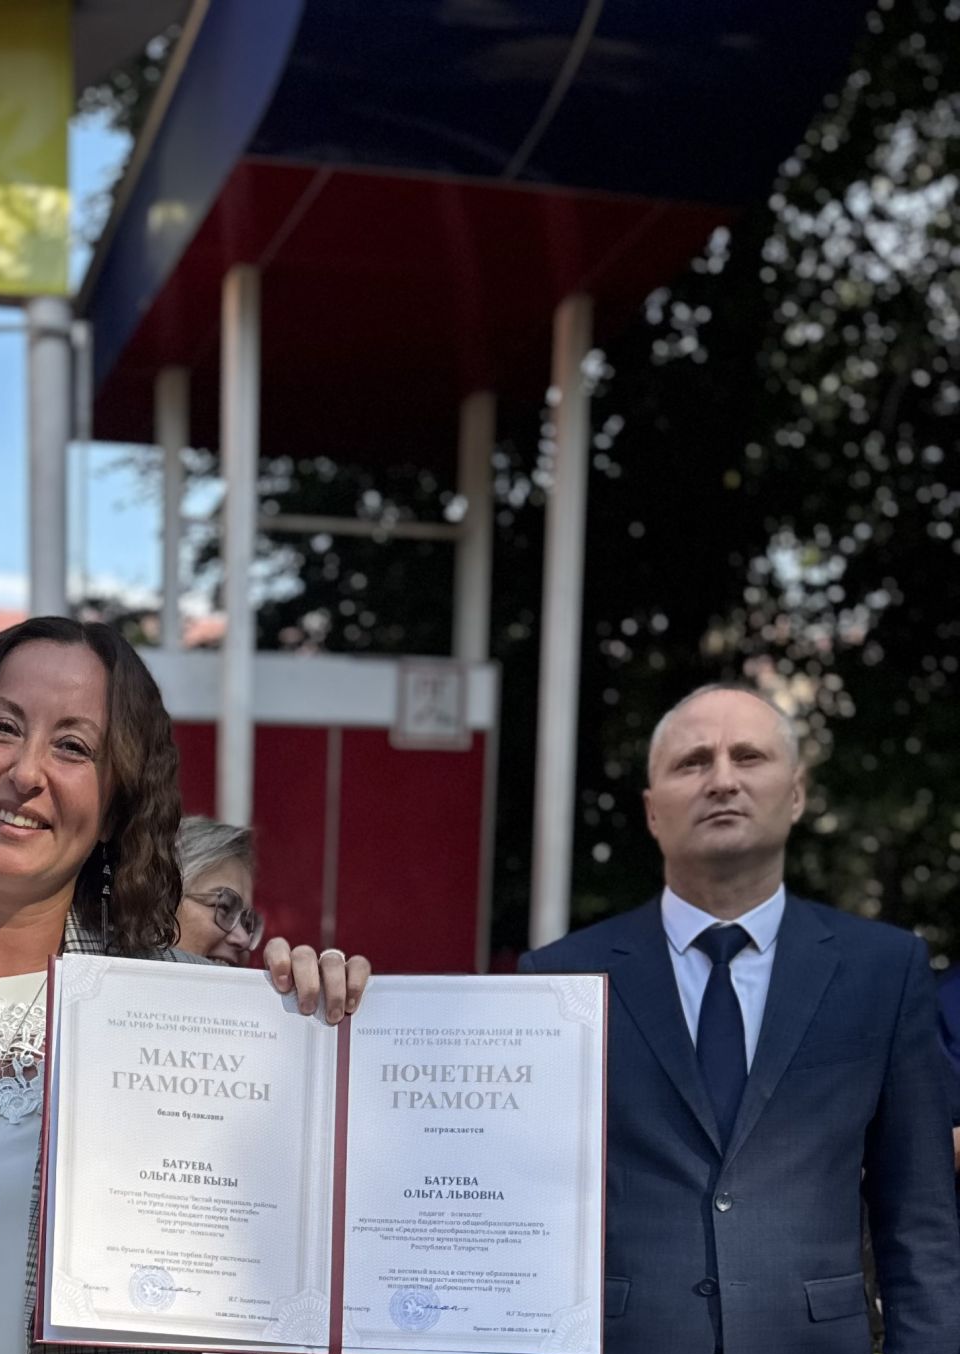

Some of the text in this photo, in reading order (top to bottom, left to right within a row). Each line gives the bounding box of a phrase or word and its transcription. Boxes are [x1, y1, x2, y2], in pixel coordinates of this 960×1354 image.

[126, 1010, 260, 1029] ТАТАРСТАН РЕСПУБЛИКАСЫ
[356, 1027, 439, 1036] МИНИСТЕРСТВО
[441, 1028, 513, 1037] ОБРАЗОВАНИЯ
[525, 1028, 561, 1037] НАУКИ
[393, 1037, 522, 1047] РЕСПУБЛИКИ ТАТАРСТАН
[139, 1047, 246, 1073] МАКТАУ
[380, 1063, 534, 1084] ПОЧЕТНАЯ
[111, 1071, 272, 1102] ГРАМОТАСЫ
[391, 1091, 520, 1110] ГРАМОТА
[423, 1126, 485, 1135] награждается
[162, 1158, 213, 1172] БАТУЕВА
[139, 1170, 239, 1188] ОЛЬГА ЛЕВ КЫЗЫ
[424, 1175, 479, 1187] БАТУЕВА
[403, 1188, 505, 1201] ОЛЬГА ЛЬВОВНА
